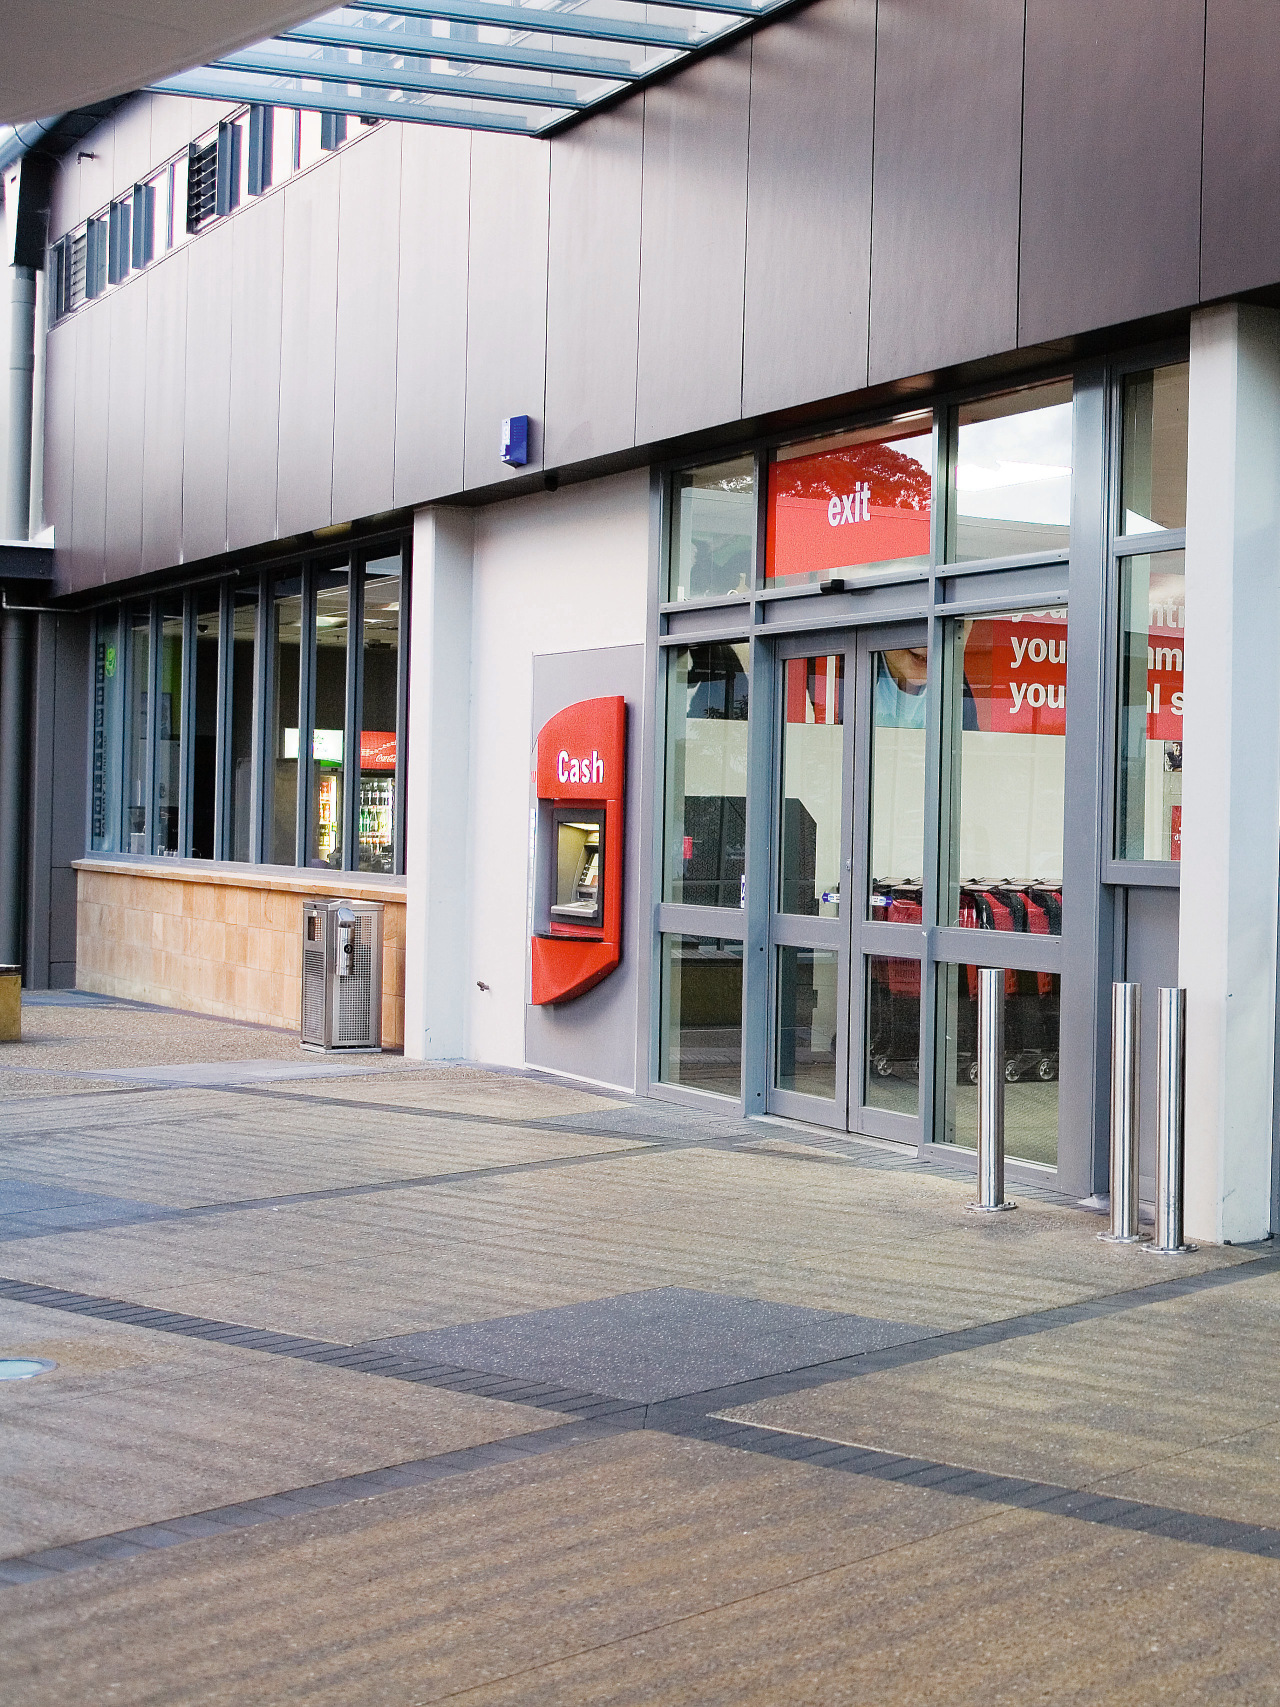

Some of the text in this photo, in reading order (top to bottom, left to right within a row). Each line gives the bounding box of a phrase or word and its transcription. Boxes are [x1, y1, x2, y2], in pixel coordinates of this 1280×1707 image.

[828, 481, 871, 526] exit
[1010, 637, 1067, 668] you
[1009, 682, 1066, 714] you
[557, 750, 605, 784] Cash
